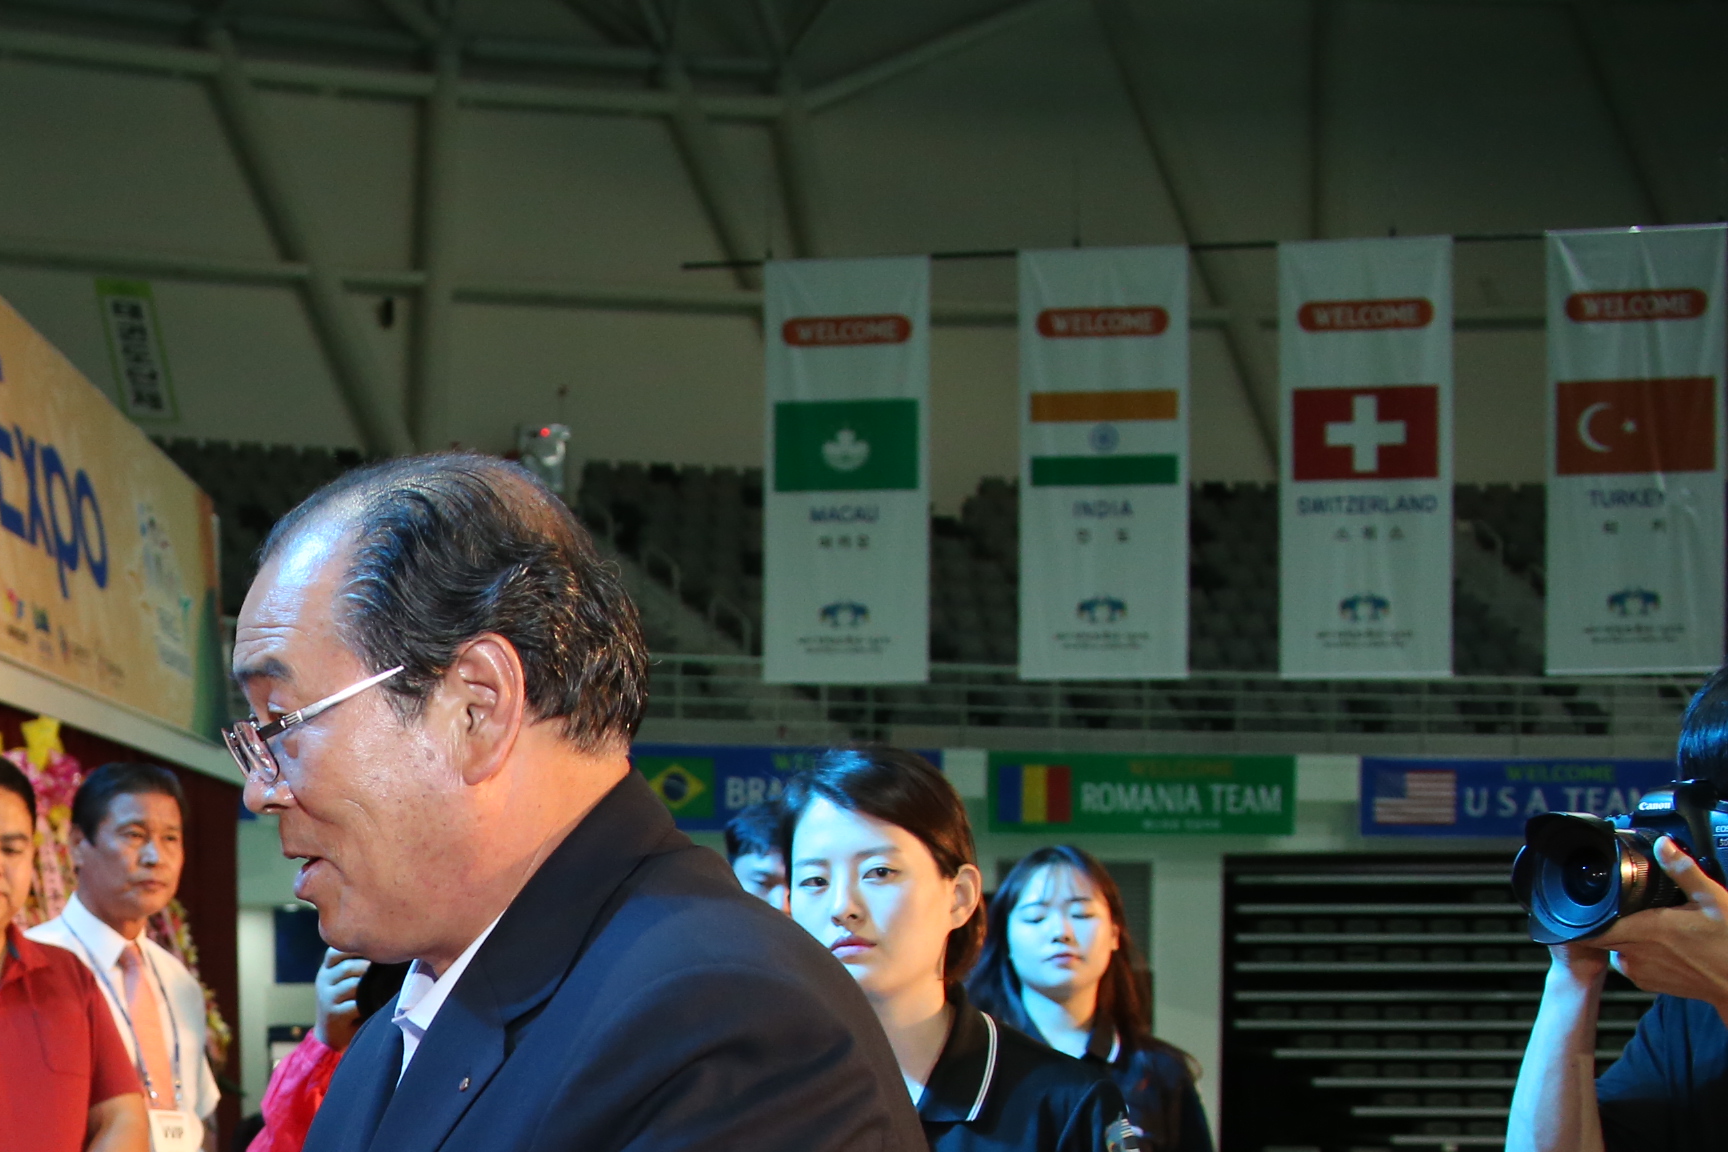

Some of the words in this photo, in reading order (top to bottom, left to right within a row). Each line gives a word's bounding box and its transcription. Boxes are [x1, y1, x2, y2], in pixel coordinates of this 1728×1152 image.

[1313, 304, 1420, 327] WELCOME
[1581, 294, 1694, 317] WELCOME
[794, 320, 901, 343] WELCOME
[1050, 311, 1156, 334] WELCOME
[1074, 501, 1134, 519] INDIA
[1296, 494, 1439, 516] SWITZERLAND
[1588, 490, 1666, 508] TURKEY
[809, 505, 880, 524] MACAU
[1505, 764, 1615, 783] WELCOME
[1080, 781, 1203, 813] ROMANIA
[1209, 783, 1283, 814] TEAM
[1638, 801, 1672, 811] Canon
